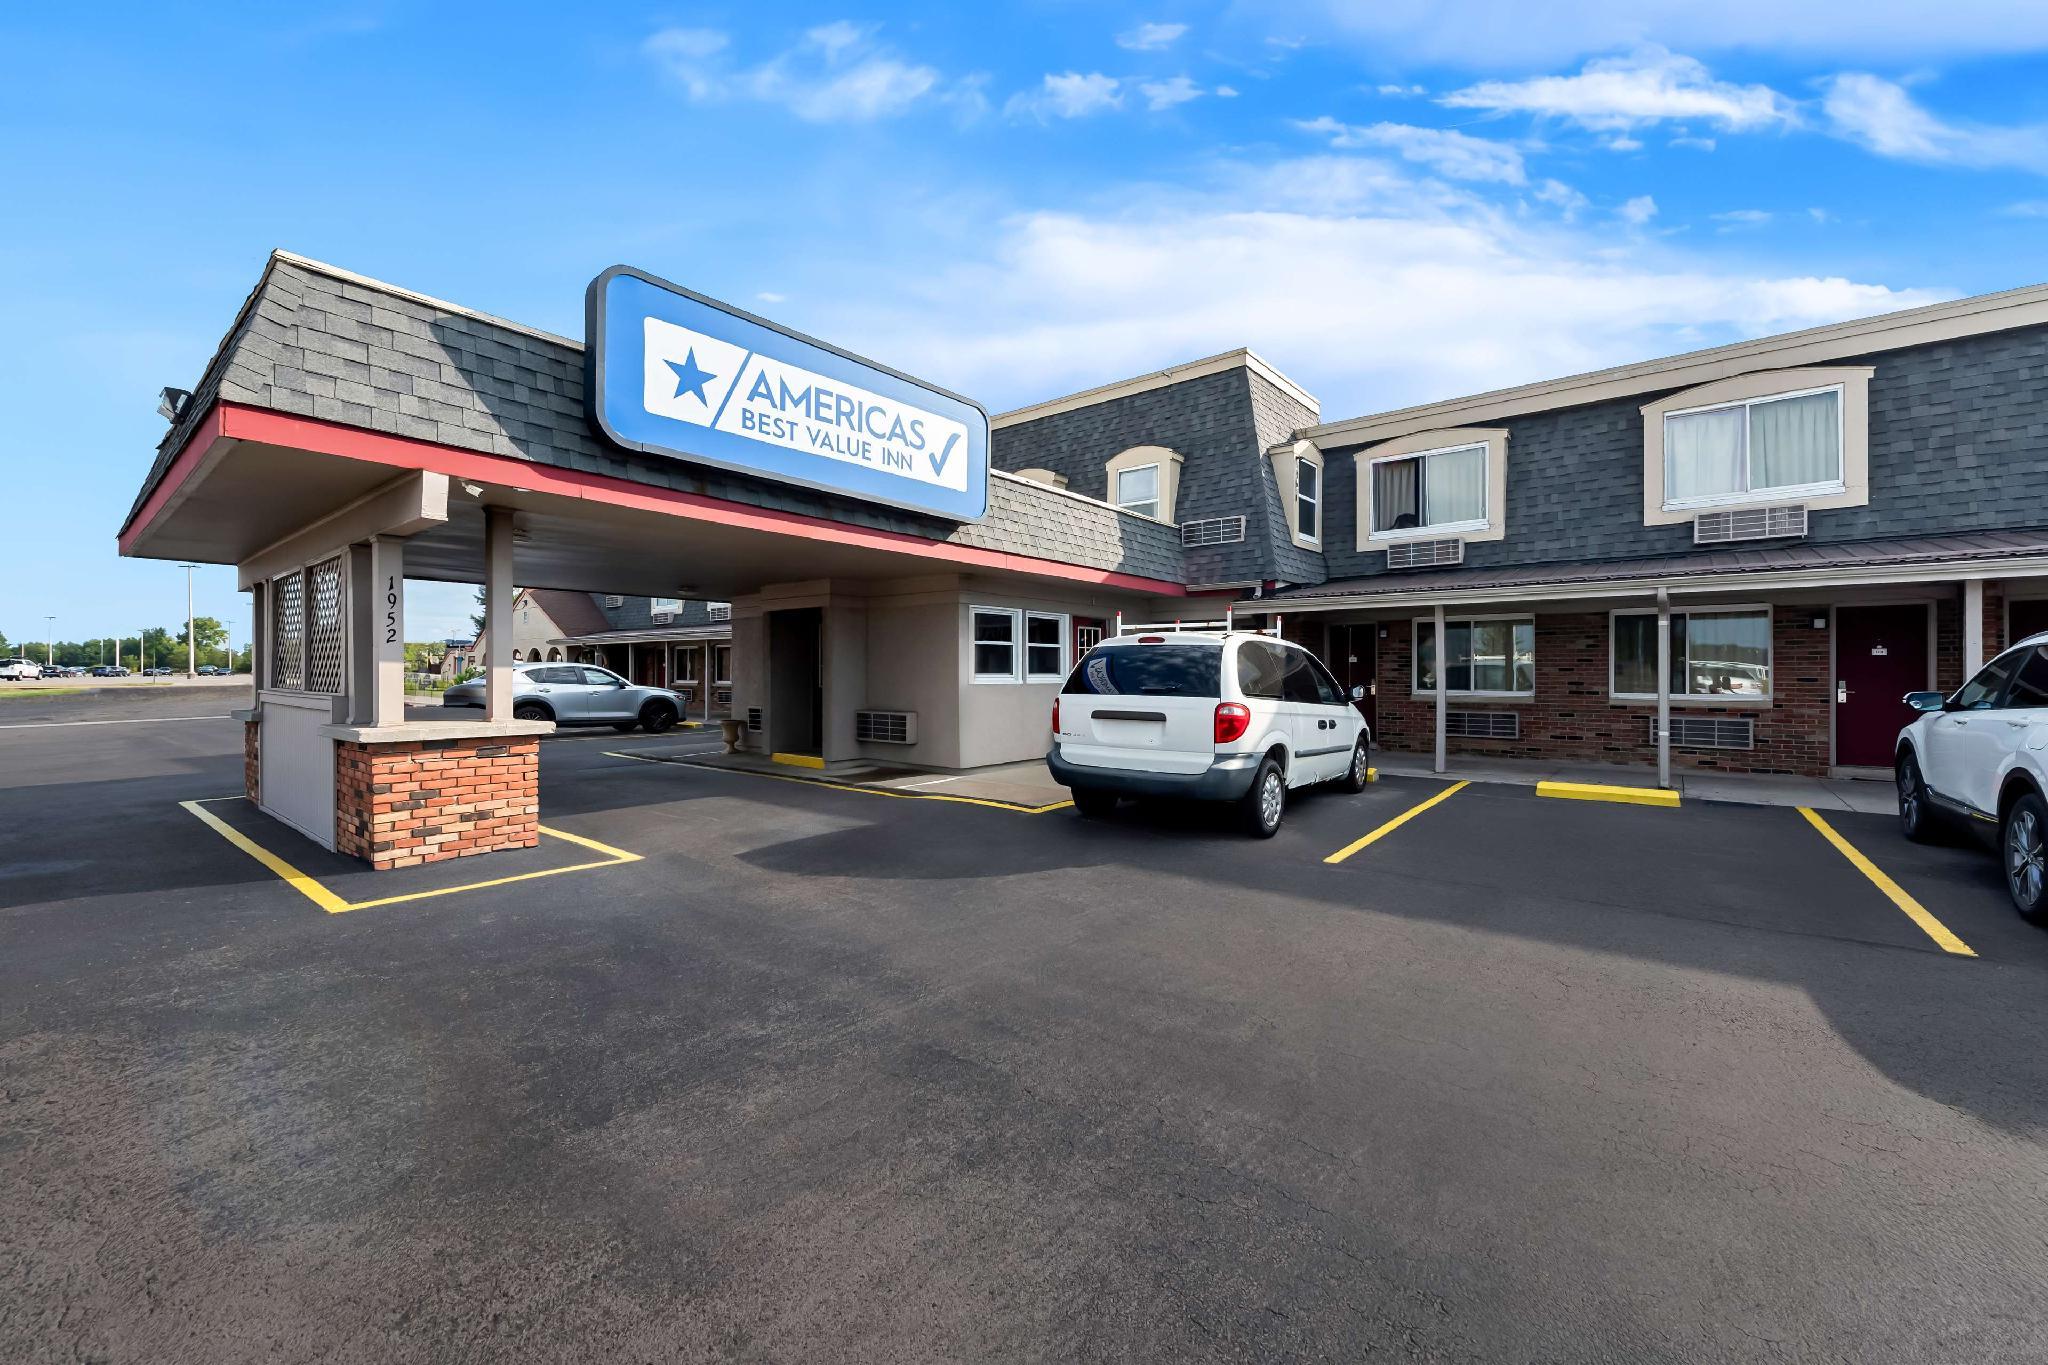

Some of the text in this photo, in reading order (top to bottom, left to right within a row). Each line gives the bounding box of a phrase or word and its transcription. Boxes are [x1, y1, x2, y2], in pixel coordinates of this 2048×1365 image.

[741, 408, 913, 472] BEST VALUE INN
[746, 369, 926, 450] AMERICAS
[386, 575, 397, 644] 1952
